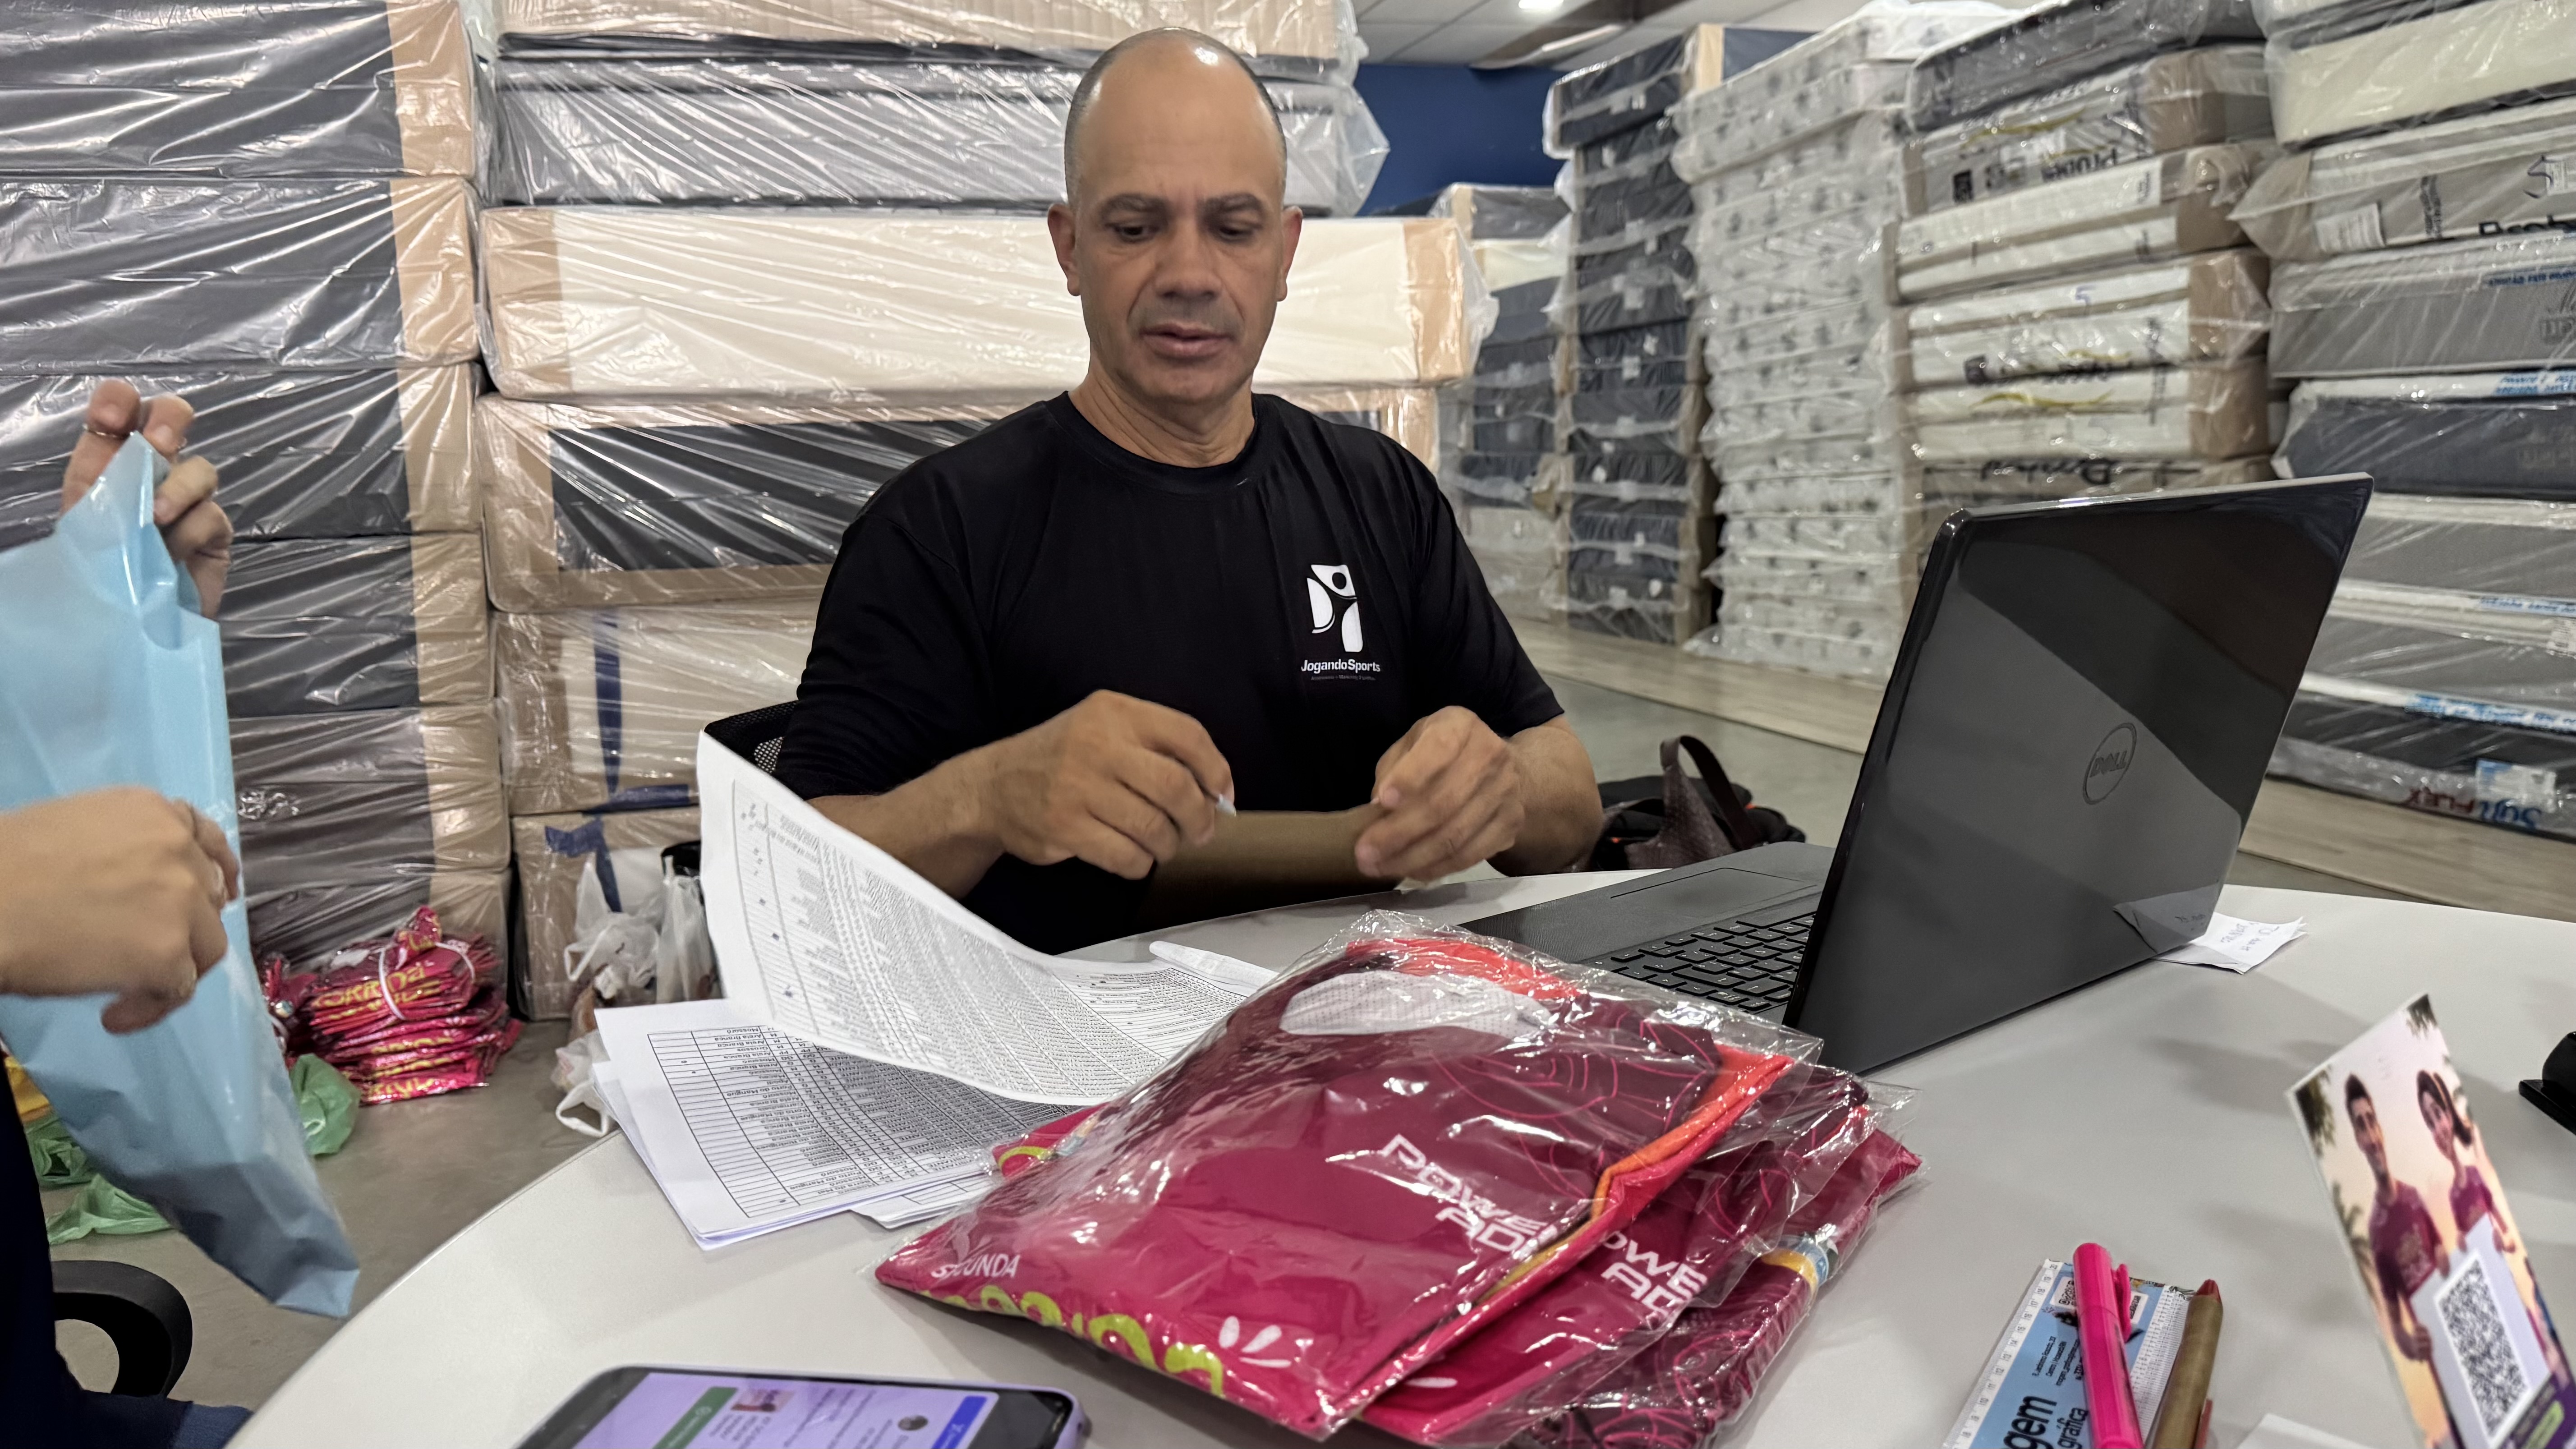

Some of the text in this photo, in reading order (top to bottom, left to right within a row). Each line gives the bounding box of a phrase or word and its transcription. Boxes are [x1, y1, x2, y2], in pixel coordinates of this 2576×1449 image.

[1301, 659, 1381, 674] JogandoSports
[2089, 750, 2127, 777] DELL
[821, 1166, 857, 1176] Mossoró
[829, 1176, 865, 1186] Mossoró
